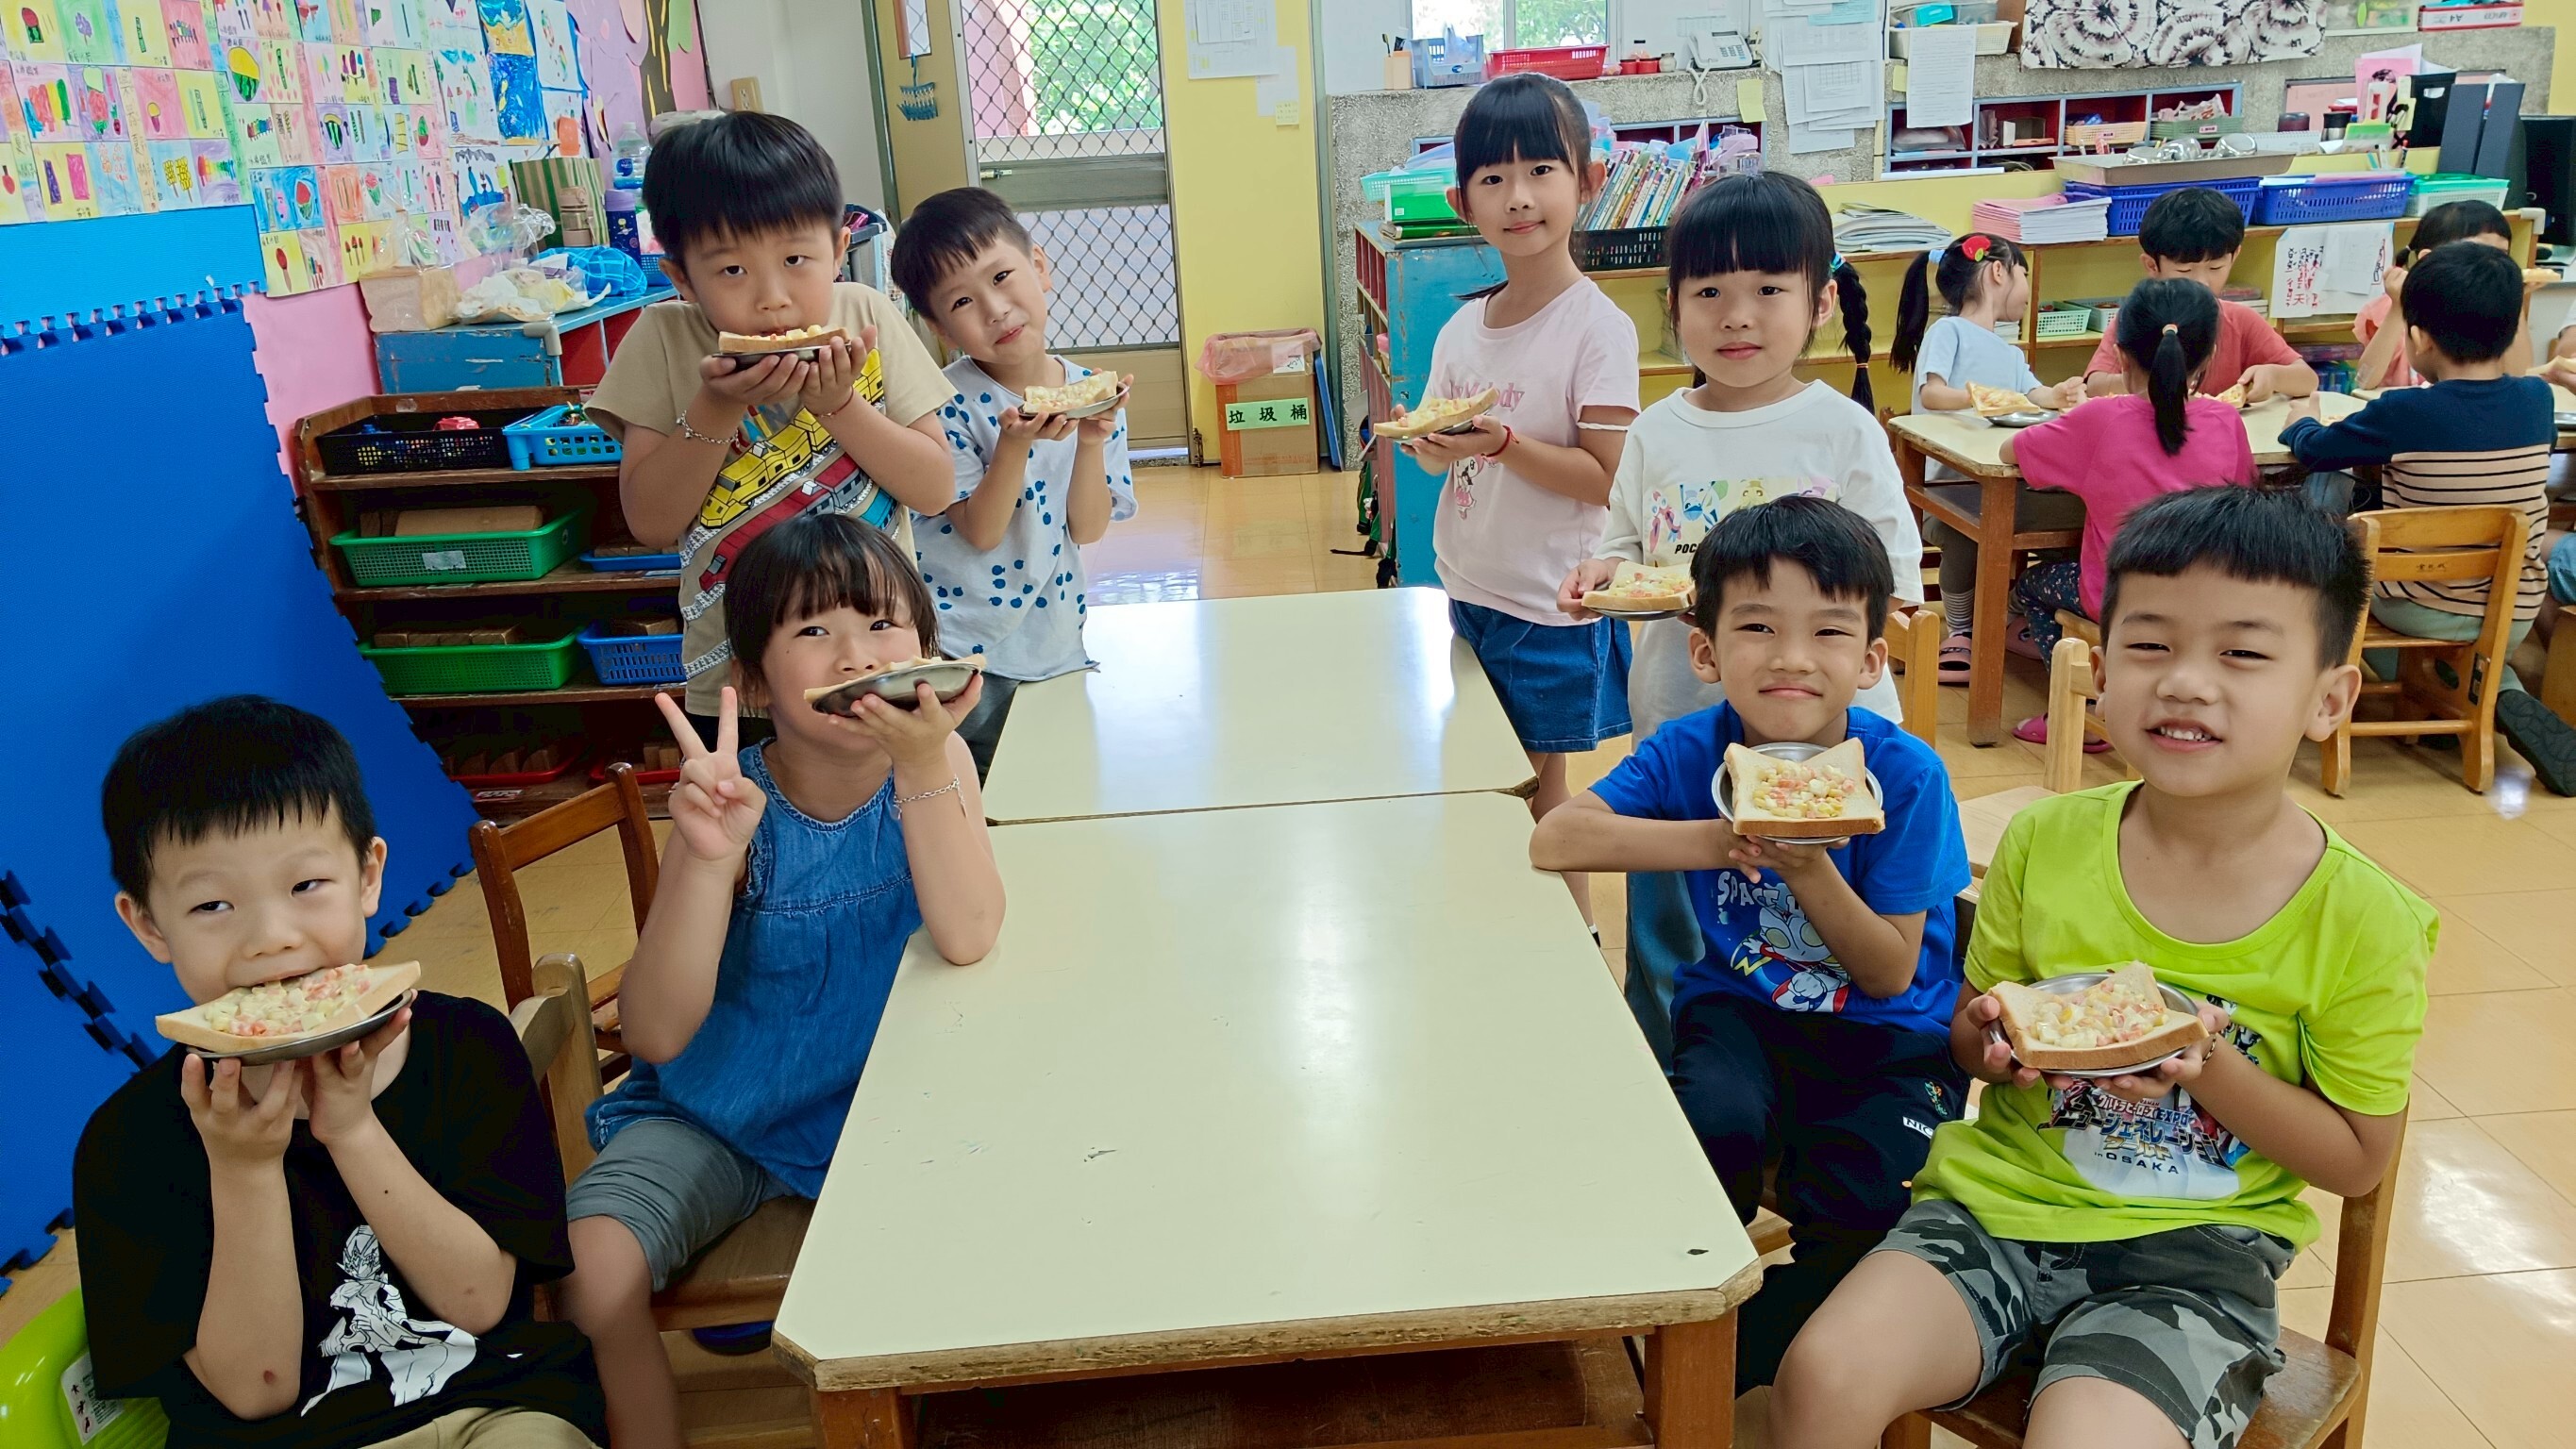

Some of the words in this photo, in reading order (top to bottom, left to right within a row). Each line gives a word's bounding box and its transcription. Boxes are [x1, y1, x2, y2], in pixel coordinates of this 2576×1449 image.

[1229, 404, 1308, 425] 垃圾桶
[1717, 871, 1780, 907] SPACE
[2157, 1108, 2190, 1126] EXPO
[2106, 1152, 2180, 1174] OSAKA
